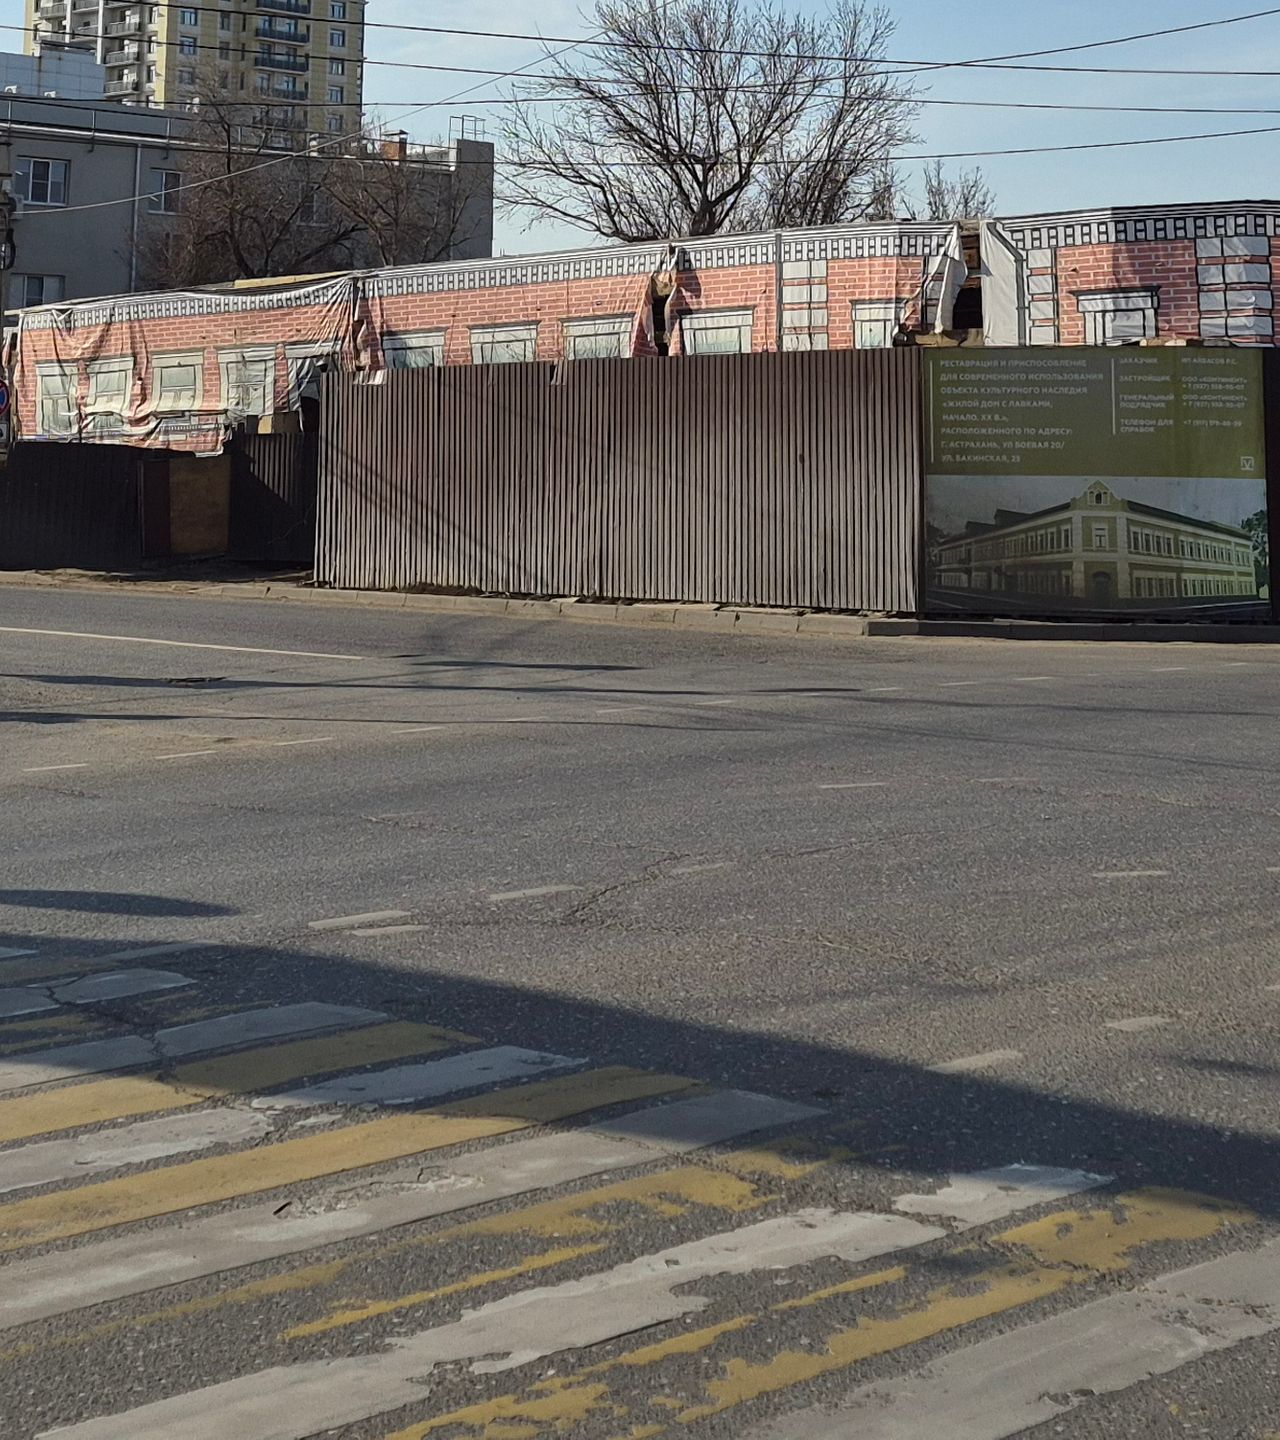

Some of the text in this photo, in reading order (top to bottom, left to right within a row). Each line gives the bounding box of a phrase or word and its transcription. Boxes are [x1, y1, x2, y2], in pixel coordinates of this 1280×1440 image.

[939, 359, 999, 368] РЕСТАВРАЦИЯ
[1008, 359, 1087, 368] ПРИСПОСОБЛЕНИЕ
[939, 373, 1104, 382] ДЛЯ СОВРЕМЕННОГО ИСПОЛЬЗОВАНИЯ
[940, 387, 1088, 395] ОБЪЕКТА КУЛЬТУРНОГО НАСЛЕДИЯ
[980, 399, 1000, 409] ДОМ
[940, 427, 1022, 436] РАСПОЛОЖЕННОГО
[1023, 427, 1036, 436] ПО
[1015, 441, 1049, 449] БОЕВАЯ
